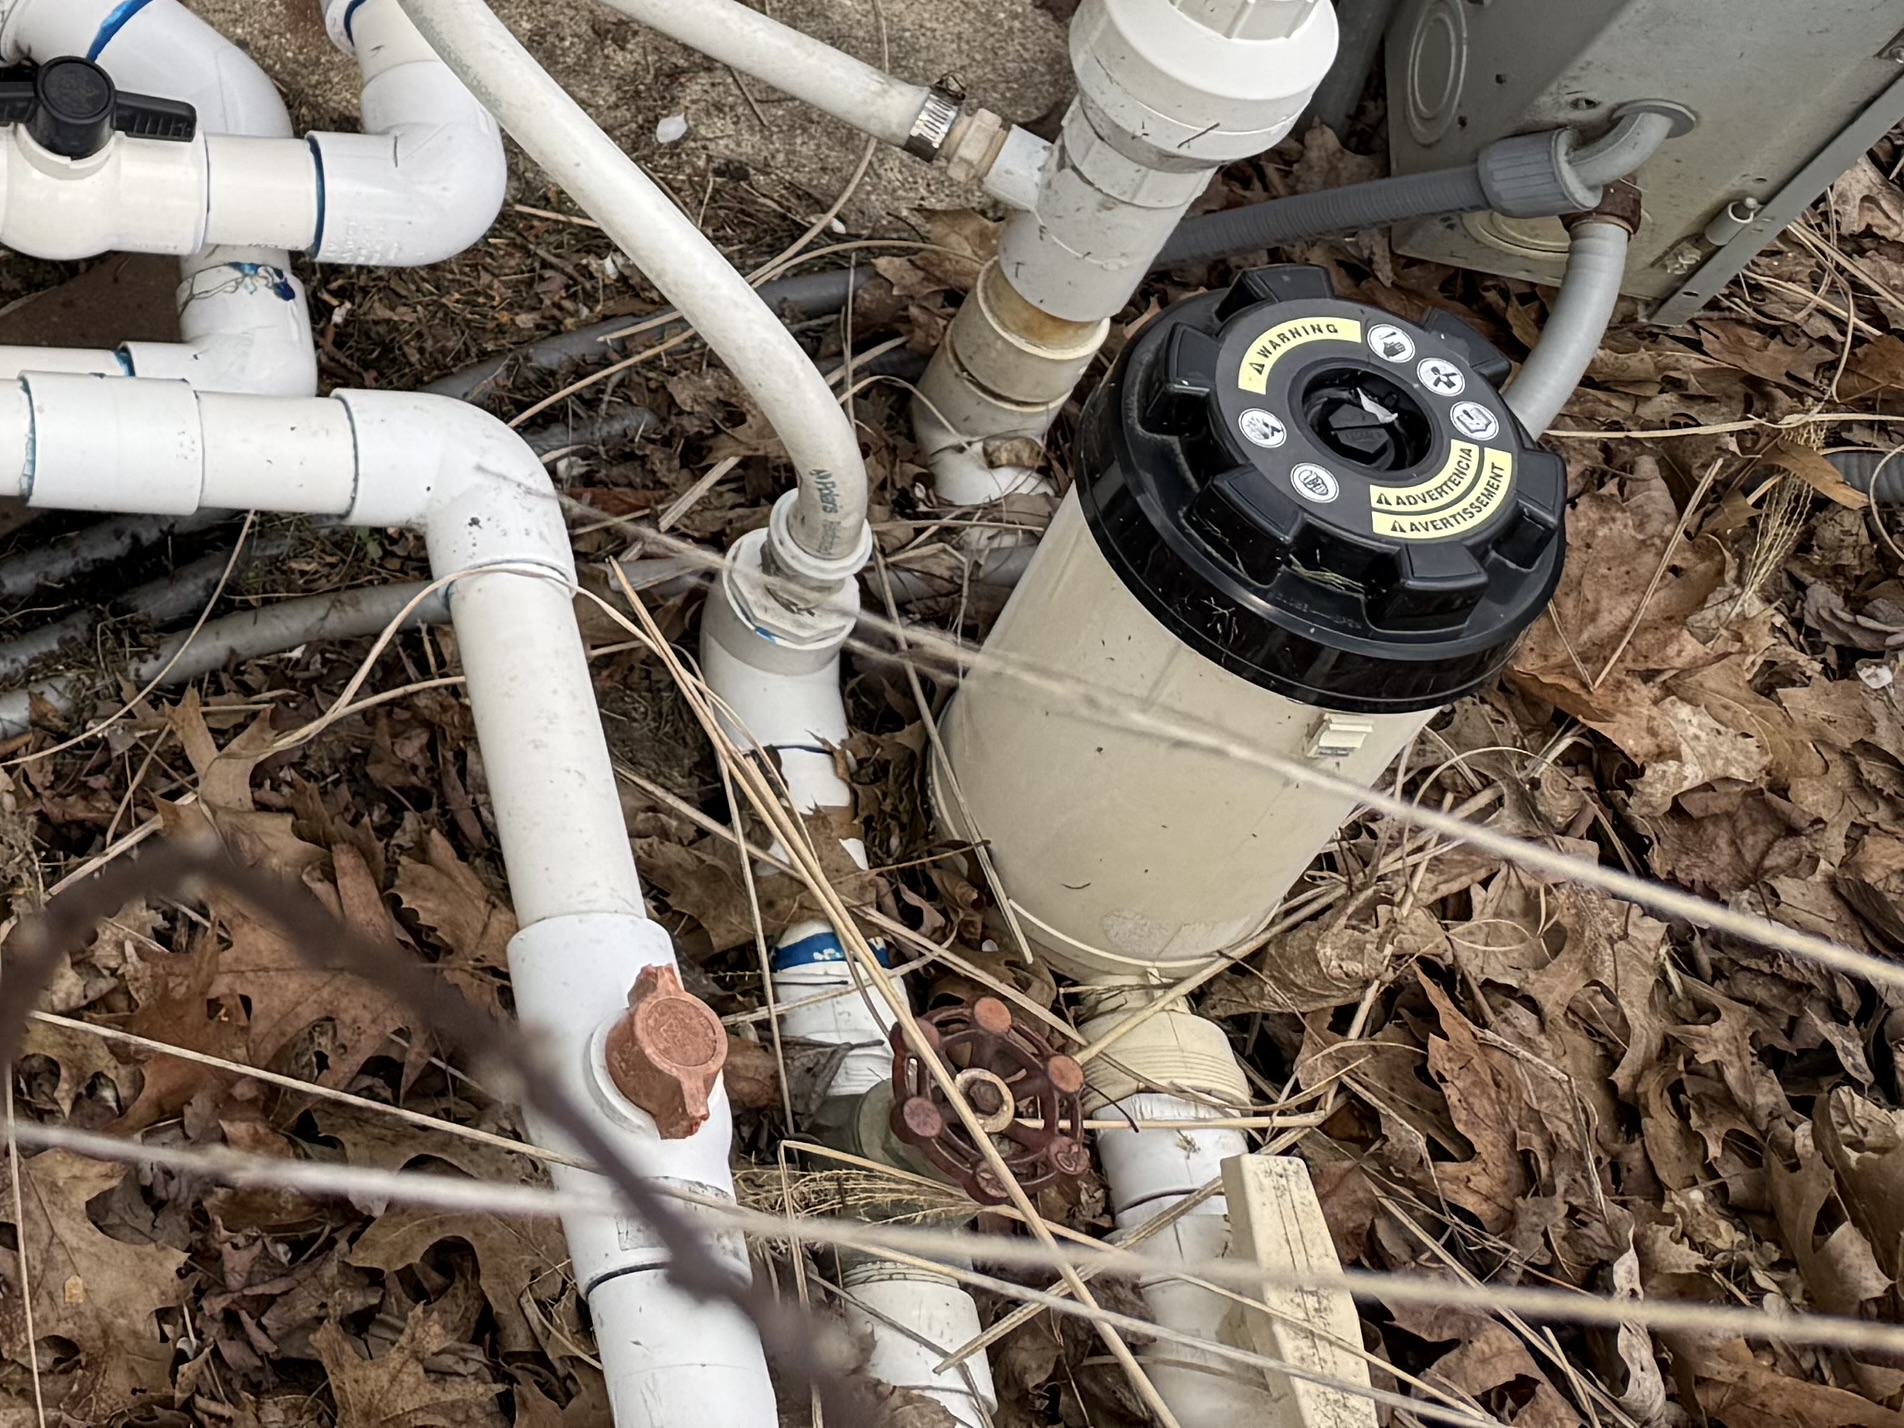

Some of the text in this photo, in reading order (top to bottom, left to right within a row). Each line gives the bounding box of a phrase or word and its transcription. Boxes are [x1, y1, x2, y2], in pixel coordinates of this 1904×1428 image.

[1256, 323, 1339, 359] WARNING
[1395, 447, 1473, 506] ADVERTENCIA
[1409, 461, 1505, 533] AVERTISSEMENT
